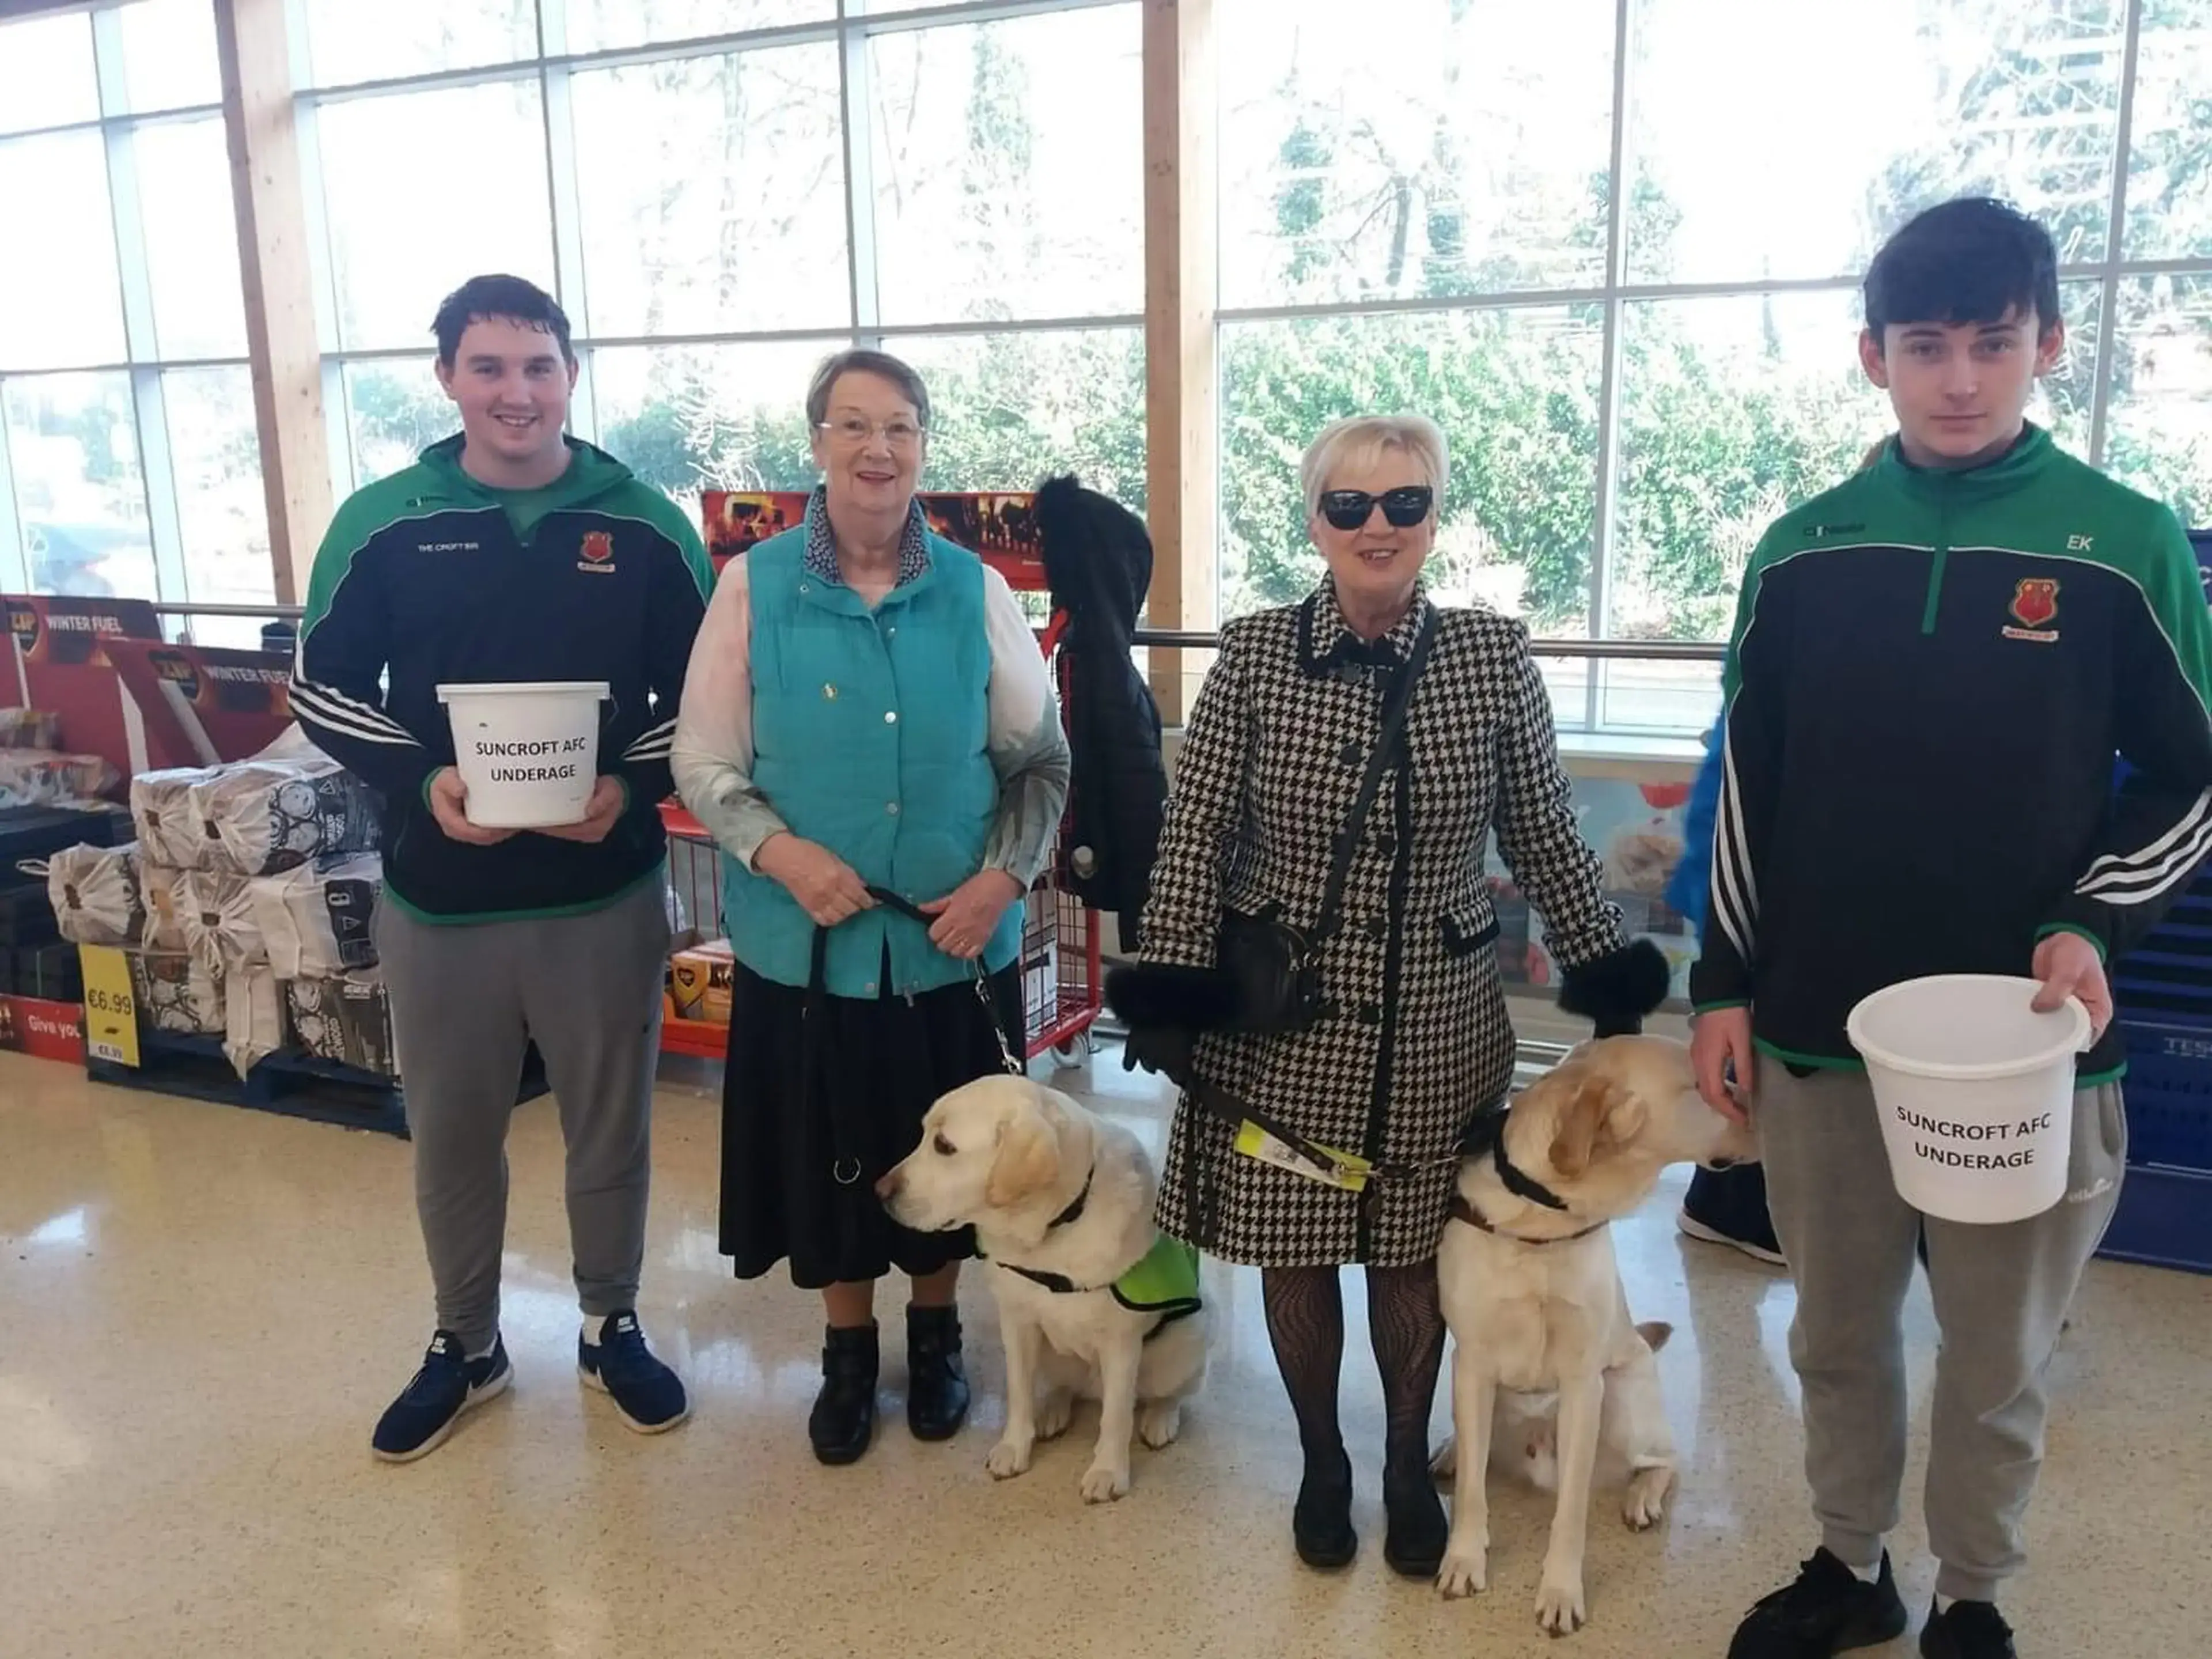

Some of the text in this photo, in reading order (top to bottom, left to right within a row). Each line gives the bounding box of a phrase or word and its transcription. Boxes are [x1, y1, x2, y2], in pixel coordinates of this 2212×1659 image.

[2067, 535, 2094, 552] EK
[45, 613, 123, 633] WINTER FUEL
[202, 666, 291, 685] WINTER FUE
[475, 736, 586, 757] SUNCROFT AFC
[491, 764, 577, 782] UNDERAGE
[88, 988, 131, 1016] €6.99
[28, 1015, 57, 1034] Give
[2163, 1036, 2212, 1057] TES
[1896, 1105, 2052, 1141] SUNCROFT AFC
[1914, 1141, 2035, 1170] UNDERAGE
